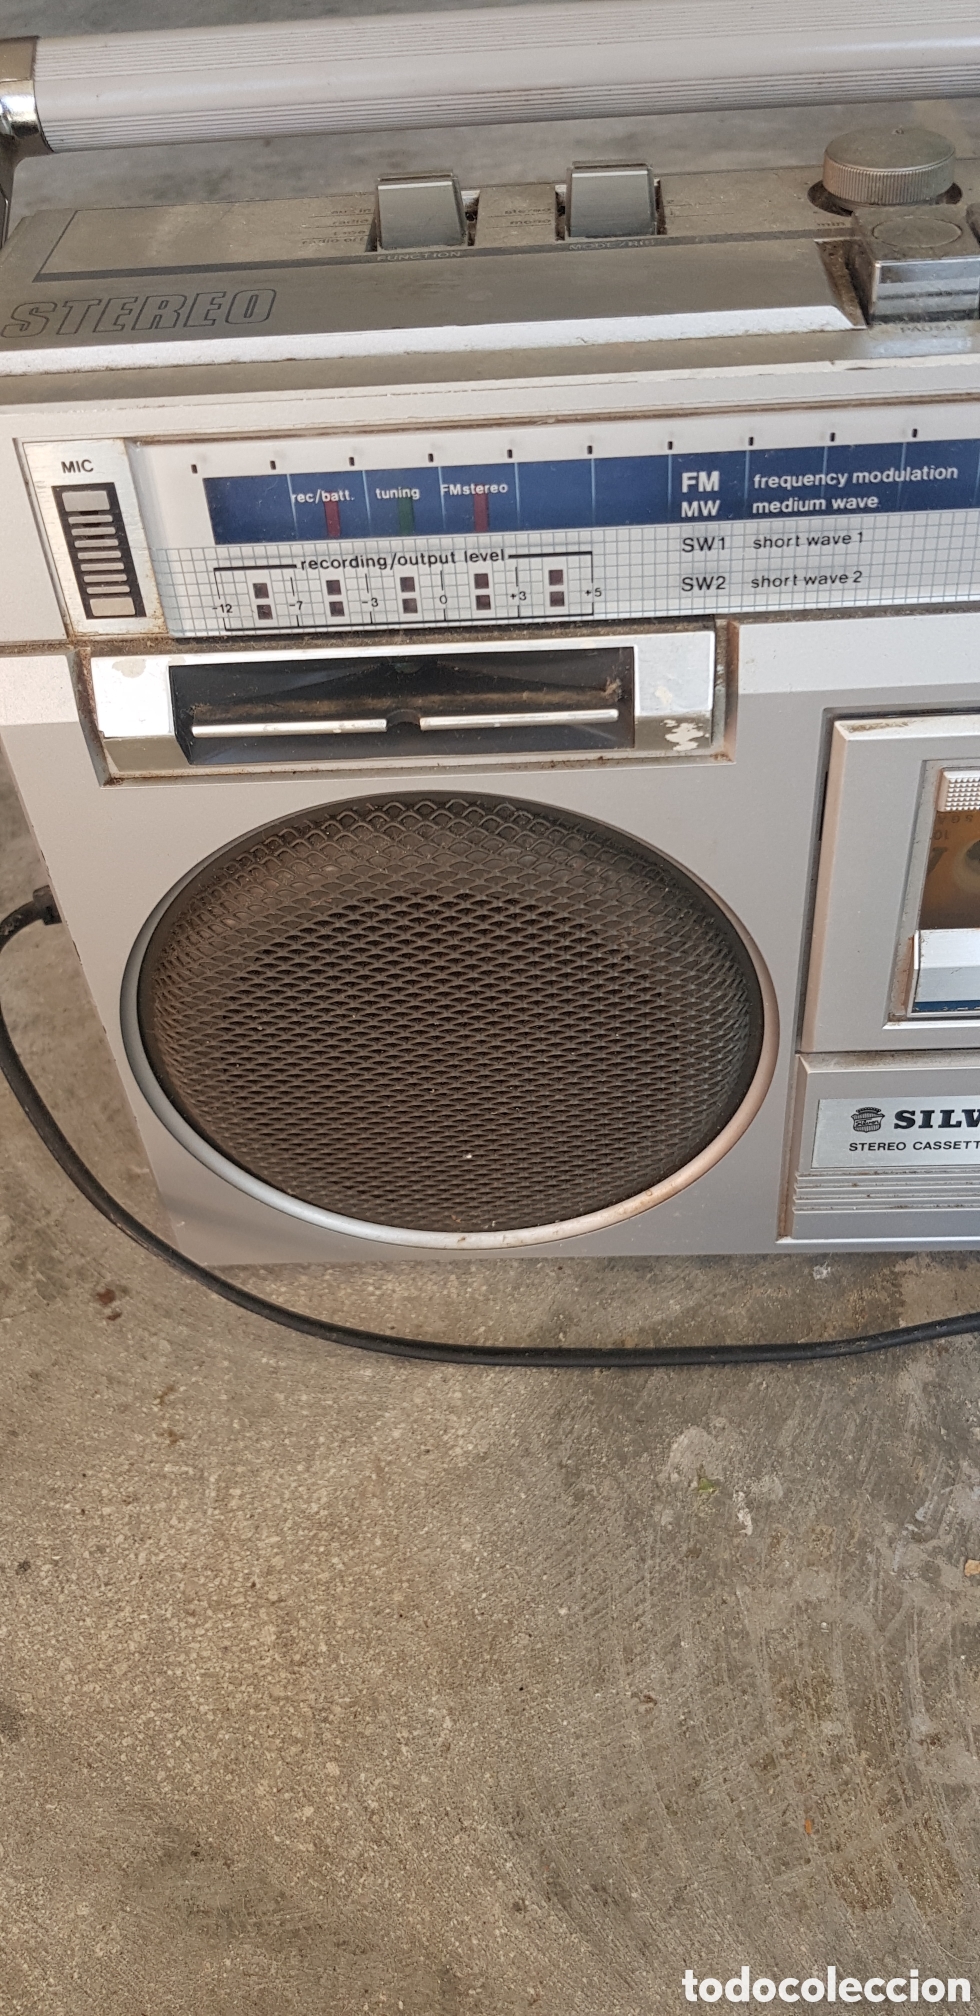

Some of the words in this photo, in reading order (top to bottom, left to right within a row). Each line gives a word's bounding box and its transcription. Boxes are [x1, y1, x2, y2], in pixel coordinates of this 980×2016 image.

[377, 251, 461, 261] FUNCTION
[1, 288, 277, 338] STEREO
[61, 459, 94, 474] MIC
[681, 471, 720, 493] FM
[753, 471, 848, 491] frequency
[852, 465, 959, 484] modulation
[291, 488, 355, 504] rec/batt.
[376, 486, 420, 500] tuning
[680, 500, 720, 518] MW
[752, 498, 826, 515] medium
[831, 495, 879, 510] wave
[681, 536, 726, 553] SW1
[752, 534, 801, 550] short
[806, 534, 852, 547] wave
[857, 532, 864, 544] 1
[301, 552, 457, 571] recording/output
[464, 549, 504, 563] level
[681, 575, 727, 592] SW2
[750, 574, 798, 589] short
[803, 573, 849, 586] wave
[852, 571, 863, 584] 2
[212, 603, 233, 614] -12
[289, 601, 303, 610] -7
[361, 598, 379, 608] -3
[439, 594, 448, 604] 0
[509, 591, 527, 601] +3
[584, 587, 602, 597] +5
[848, 1142, 907, 1152] STEREO
